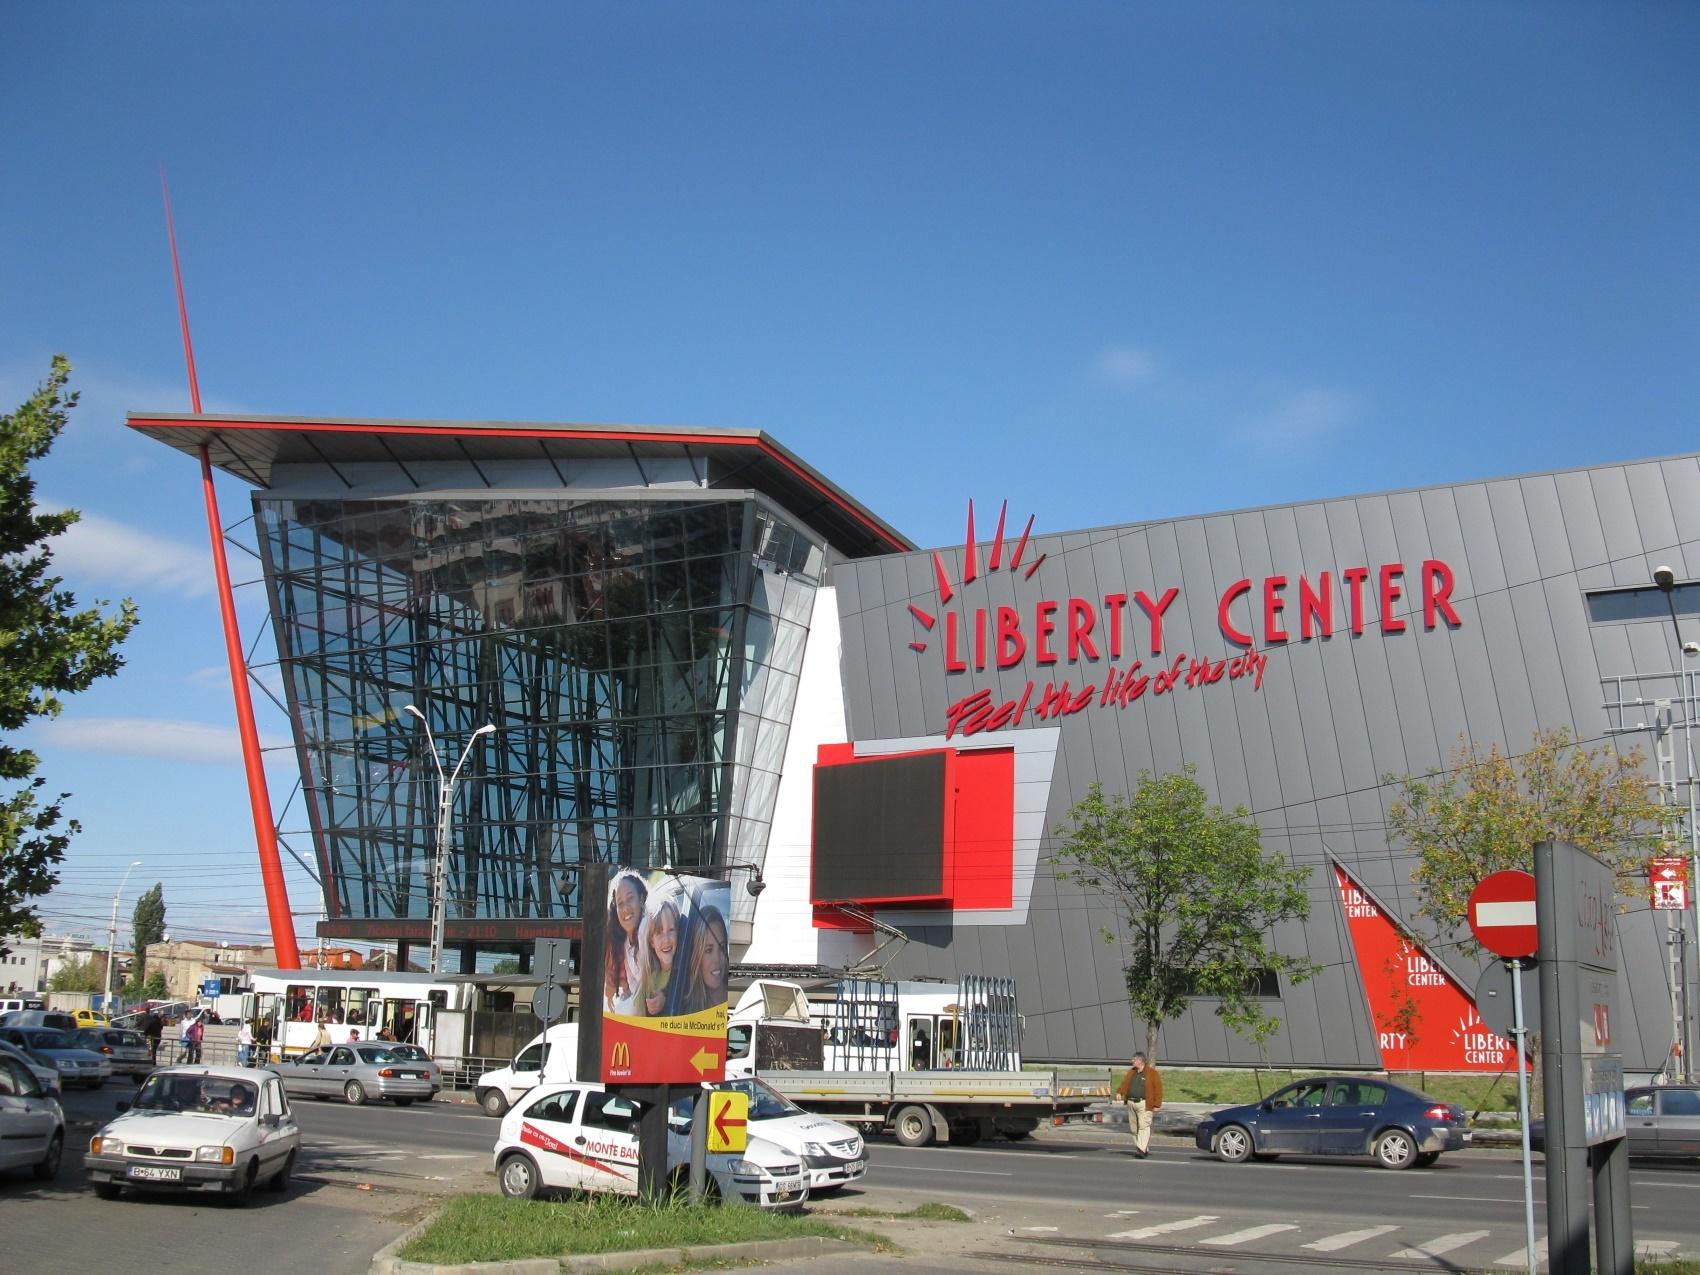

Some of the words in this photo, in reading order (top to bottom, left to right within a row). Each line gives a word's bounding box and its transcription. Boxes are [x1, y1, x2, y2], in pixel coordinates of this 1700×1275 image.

[945, 587, 1179, 671] LIBERTY
[1218, 559, 1462, 645] CENTER
[945, 680, 1034, 741] Feel
[1035, 680, 1095, 721] the
[1099, 660, 1150, 709] life
[1153, 653, 1186, 695] of
[1185, 655, 1226, 690] the
[1228, 647, 1268, 692] city
[1345, 905, 1377, 918] ENTER
[1408, 973, 1446, 986] CENTER
[660, 1021, 668, 1029] ne
[669, 1020, 683, 1029] duci
[683, 1020, 689, 1030] la
[1380, 1033, 1407, 1049] RTY
[1465, 1051, 1504, 1063] CENTER
[586, 1140, 618, 1157] MONTE
